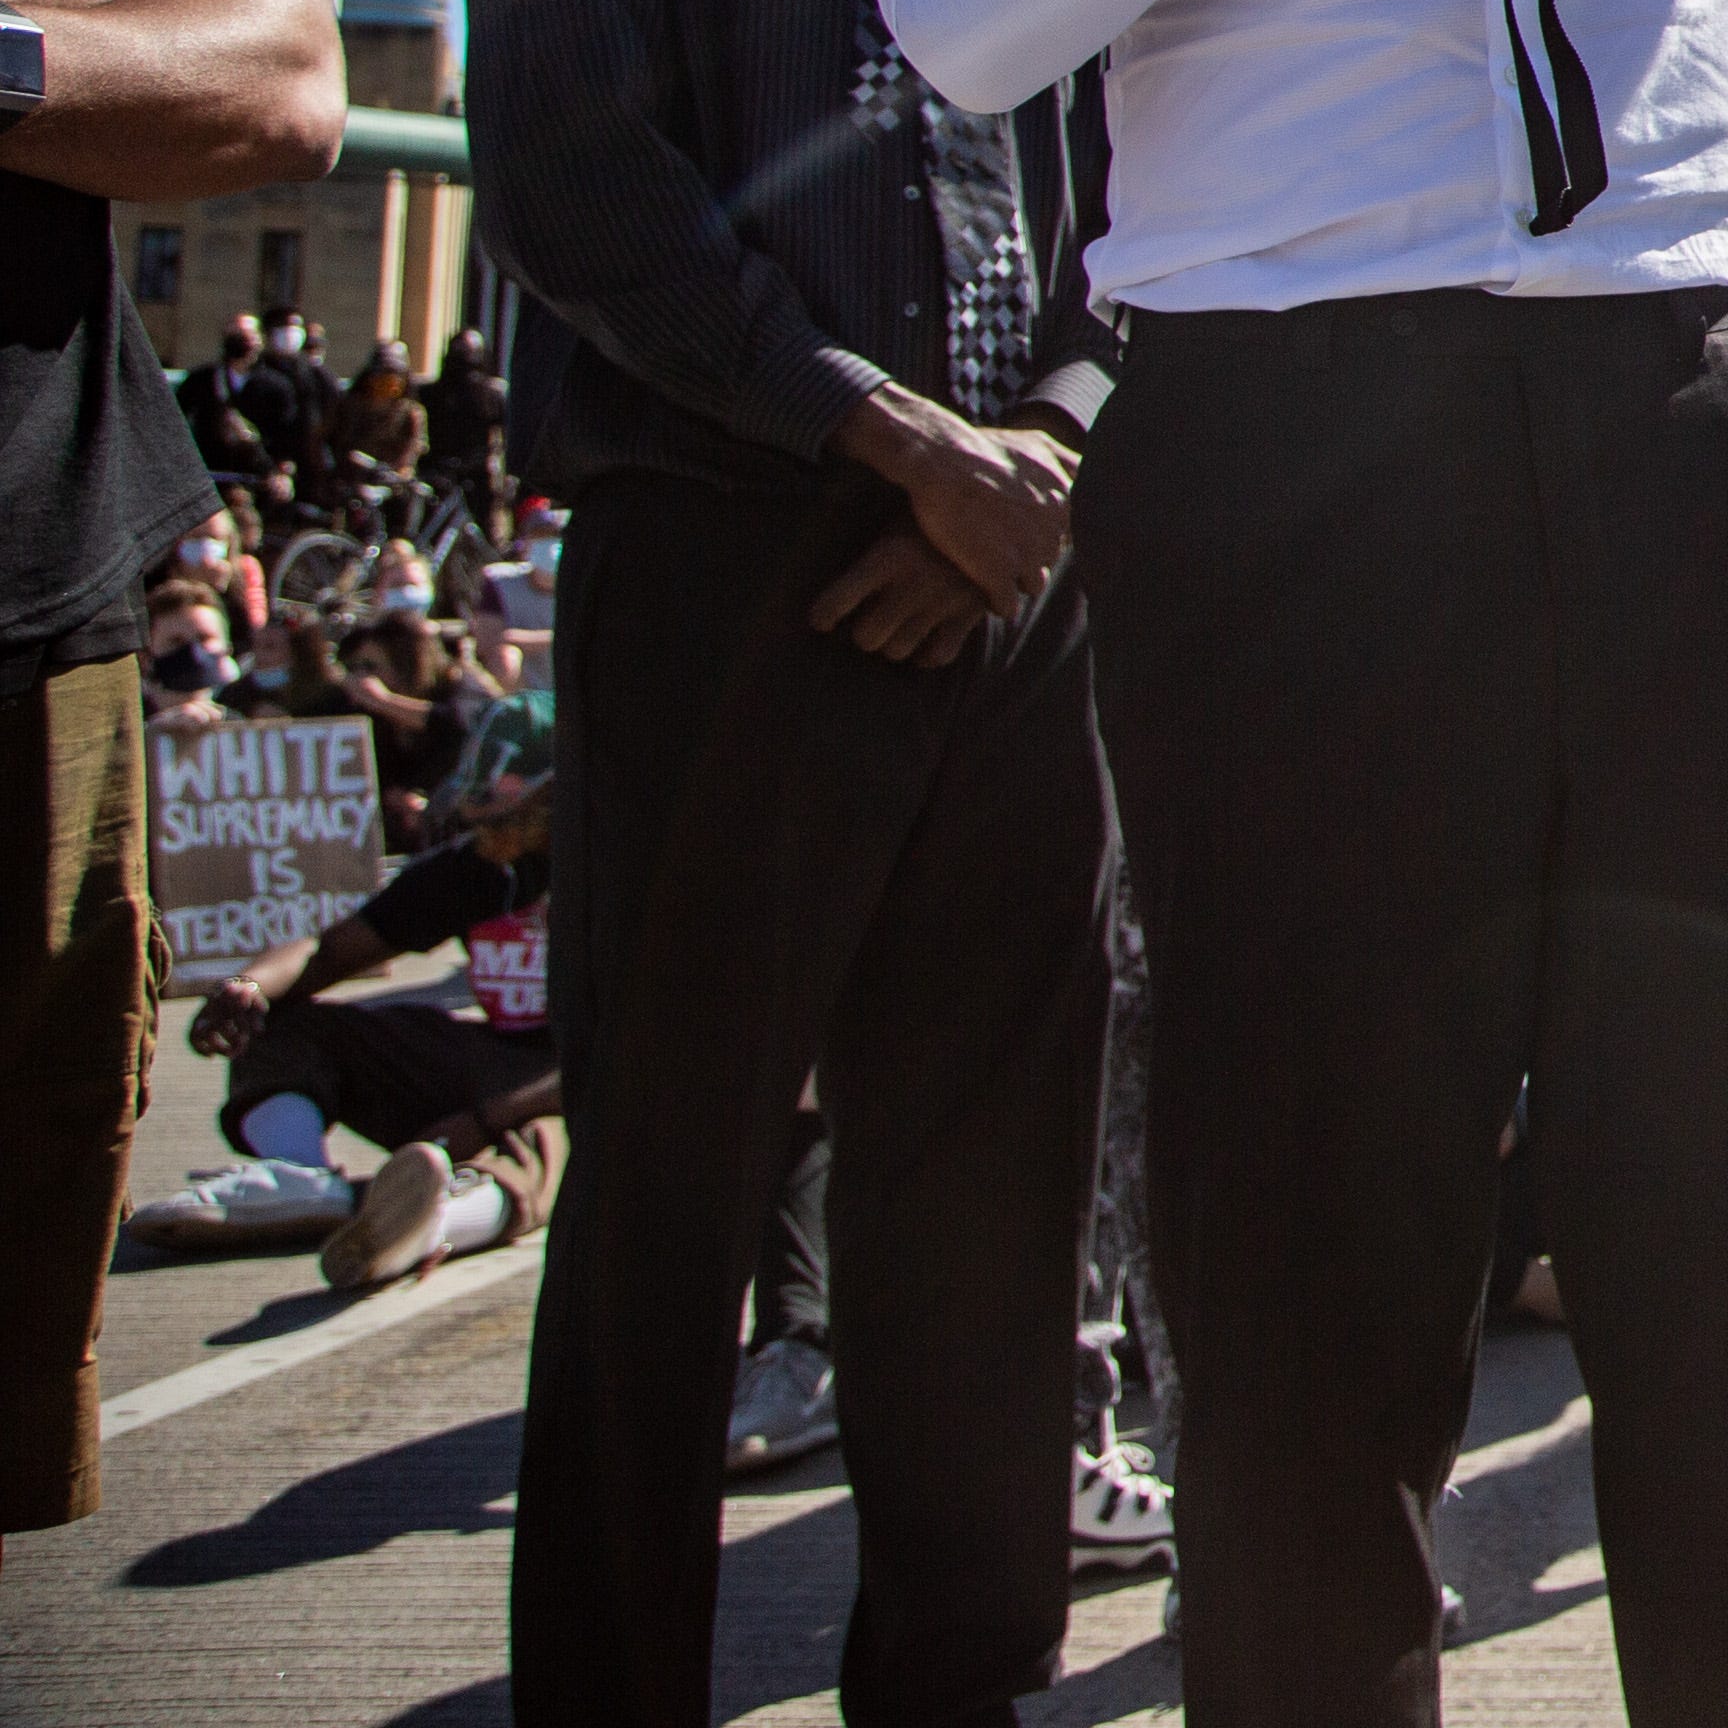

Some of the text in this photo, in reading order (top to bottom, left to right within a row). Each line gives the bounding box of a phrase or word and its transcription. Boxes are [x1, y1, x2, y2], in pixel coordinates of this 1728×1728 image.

[157, 726, 368, 801] WHITE
[158, 796, 378, 854] SUPREMACY
[251, 847, 305, 894] IS
